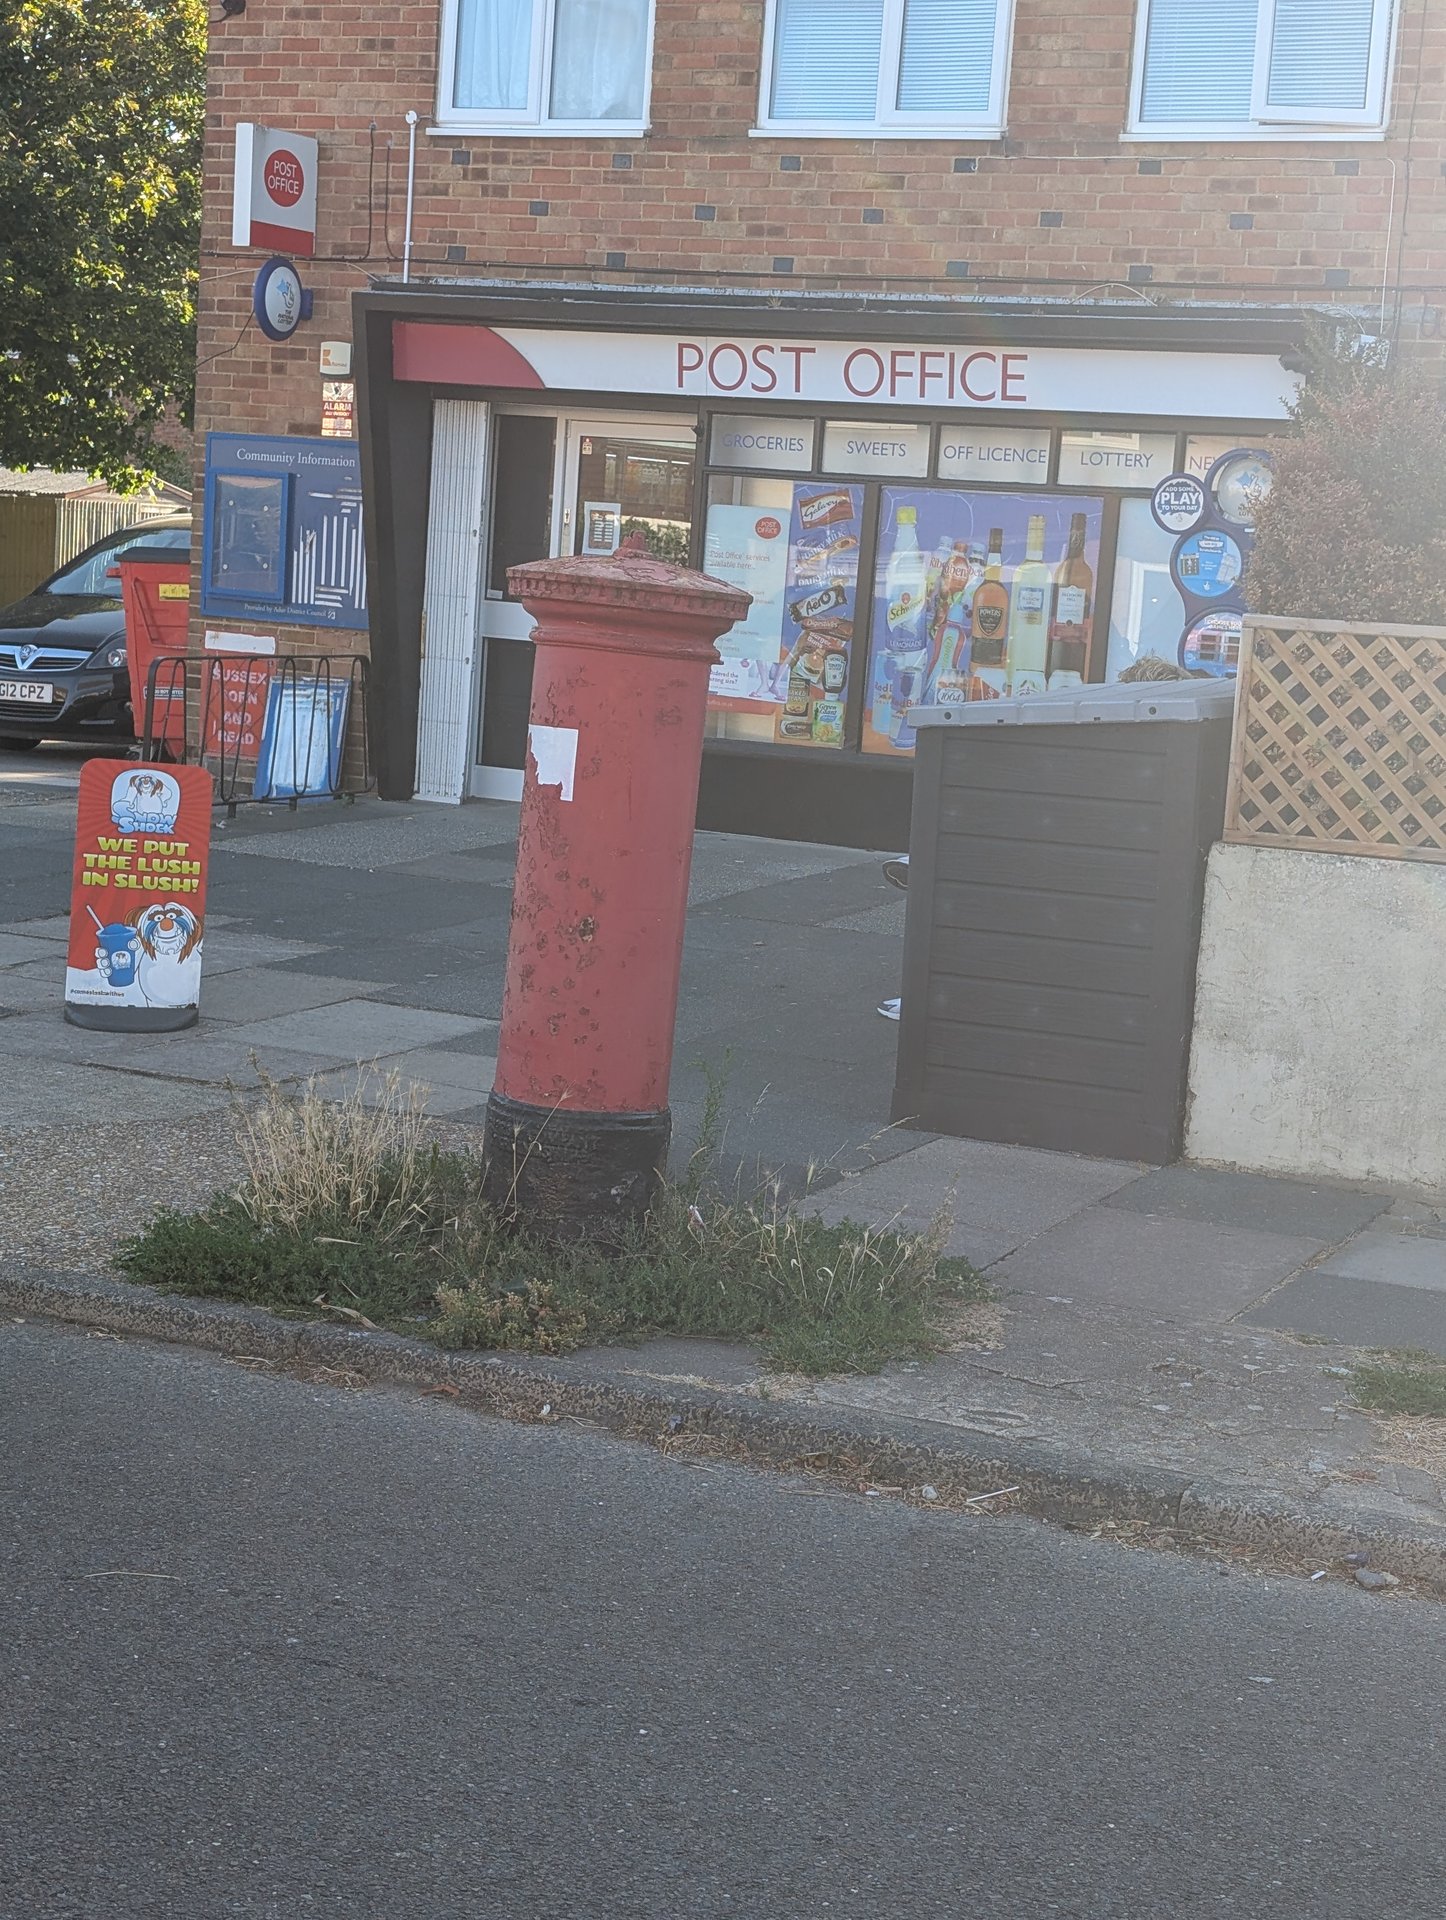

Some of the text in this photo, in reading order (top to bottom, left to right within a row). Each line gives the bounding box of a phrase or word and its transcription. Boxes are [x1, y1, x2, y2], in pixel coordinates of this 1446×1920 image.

[273, 159, 297, 178] POST
[267, 175, 299, 195] OFFICE
[677, 341, 1029, 402] POST OFFICE
[323, 402, 352, 411] ALARM
[722, 433, 804, 452] GROCERIES
[846, 440, 906, 458] SWEETS
[236, 448, 356, 467] Community Information
[943, 445, 1047, 464] OFF LICENCE
[1080, 451, 1154, 469] LOTTERY
[1189, 455, 1217, 471] NE
[1160, 492, 1200, 505] PLAY
[804, 499, 839, 519] Galaxy
[745, 554, 770, 562] services
[244, 603, 266, 611] Provided
[286, 607, 305, 615] District
[306, 608, 327, 617] Council
[979, 607, 1002, 617] POWERS
[212, 667, 268, 685] SUSSEX
[20, 684, 45, 700] CPZ
[223, 689, 258, 704] ORN
[819, 703, 837, 711] Green
[819, 707, 837, 716] Giant
[223, 711, 252, 726] AND
[216, 725, 255, 745] READ
[111, 800, 178, 825] SNOW
[117, 816, 176, 834] SHOCK
[97, 836, 189, 857] WE PUT
[82, 853, 201, 876] THE LUSH
[82, 871, 200, 893] IN SLUSH!
